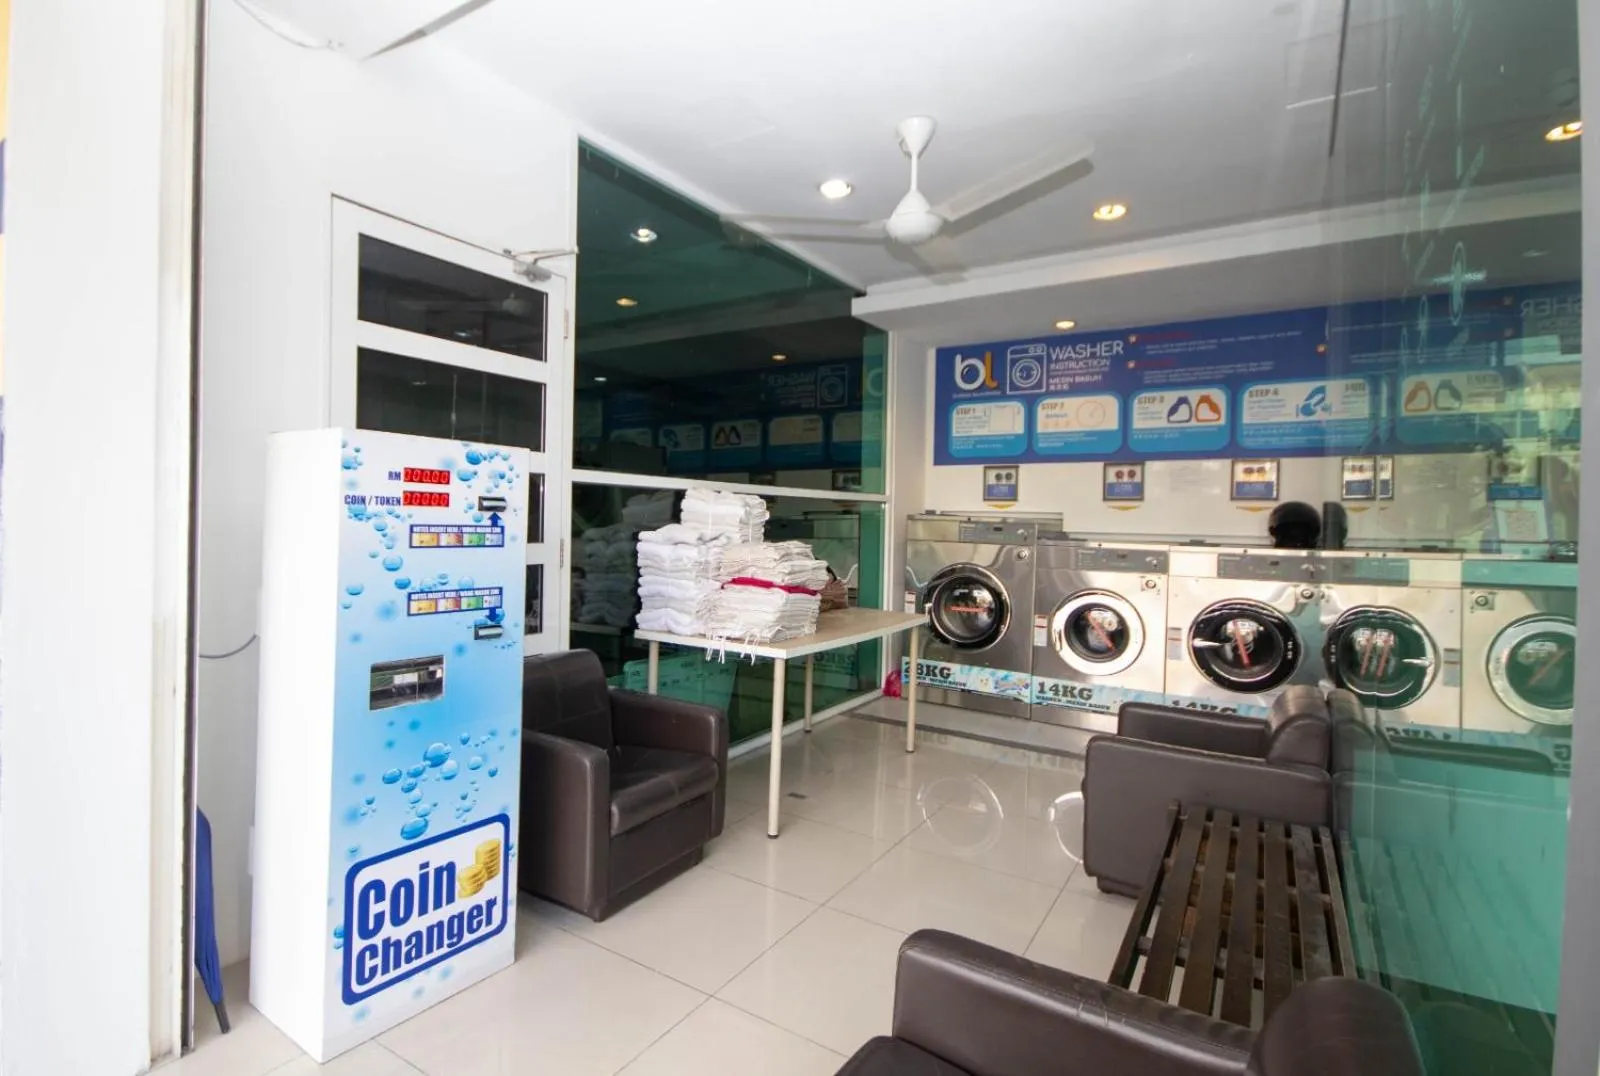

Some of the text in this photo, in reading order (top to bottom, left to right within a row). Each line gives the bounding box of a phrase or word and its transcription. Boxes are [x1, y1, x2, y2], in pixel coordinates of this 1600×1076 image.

[1049, 340, 1124, 361] WASHER
[1049, 358, 1111, 370] INSTRUCTION
[1248, 389, 1270, 398] STEP
[1137, 396, 1159, 404] STEP
[388, 471, 401, 481] RM
[344, 494, 367, 505] COIN
[375, 496, 401, 506] TOKEN
[1037, 681, 1093, 701] 14KG
[357, 861, 456, 941] Coin
[355, 896, 498, 986] Changer
